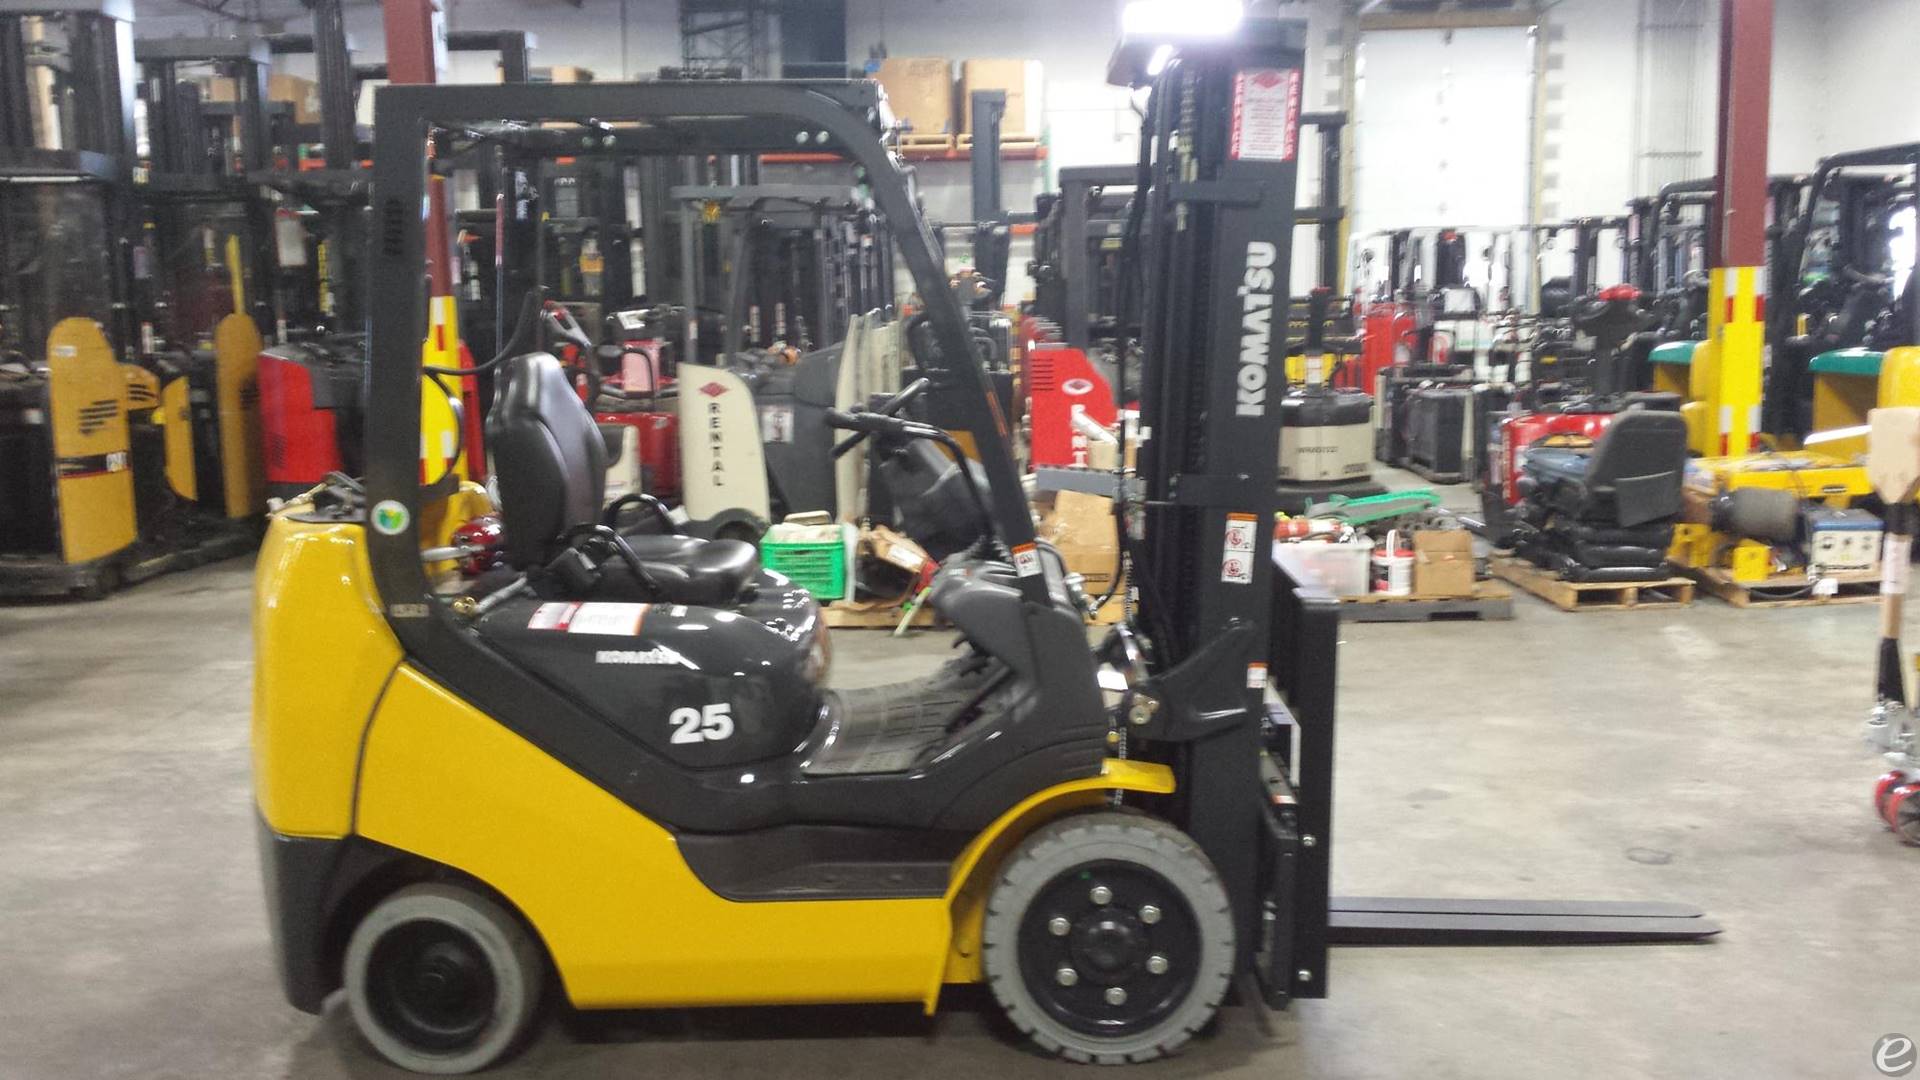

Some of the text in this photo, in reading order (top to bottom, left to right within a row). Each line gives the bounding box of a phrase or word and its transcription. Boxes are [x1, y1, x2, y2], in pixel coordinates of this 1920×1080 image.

[1236, 241, 1277, 416] KOMATSU
[708, 402, 725, 486] RENTAL
[669, 702, 735, 744] 25
